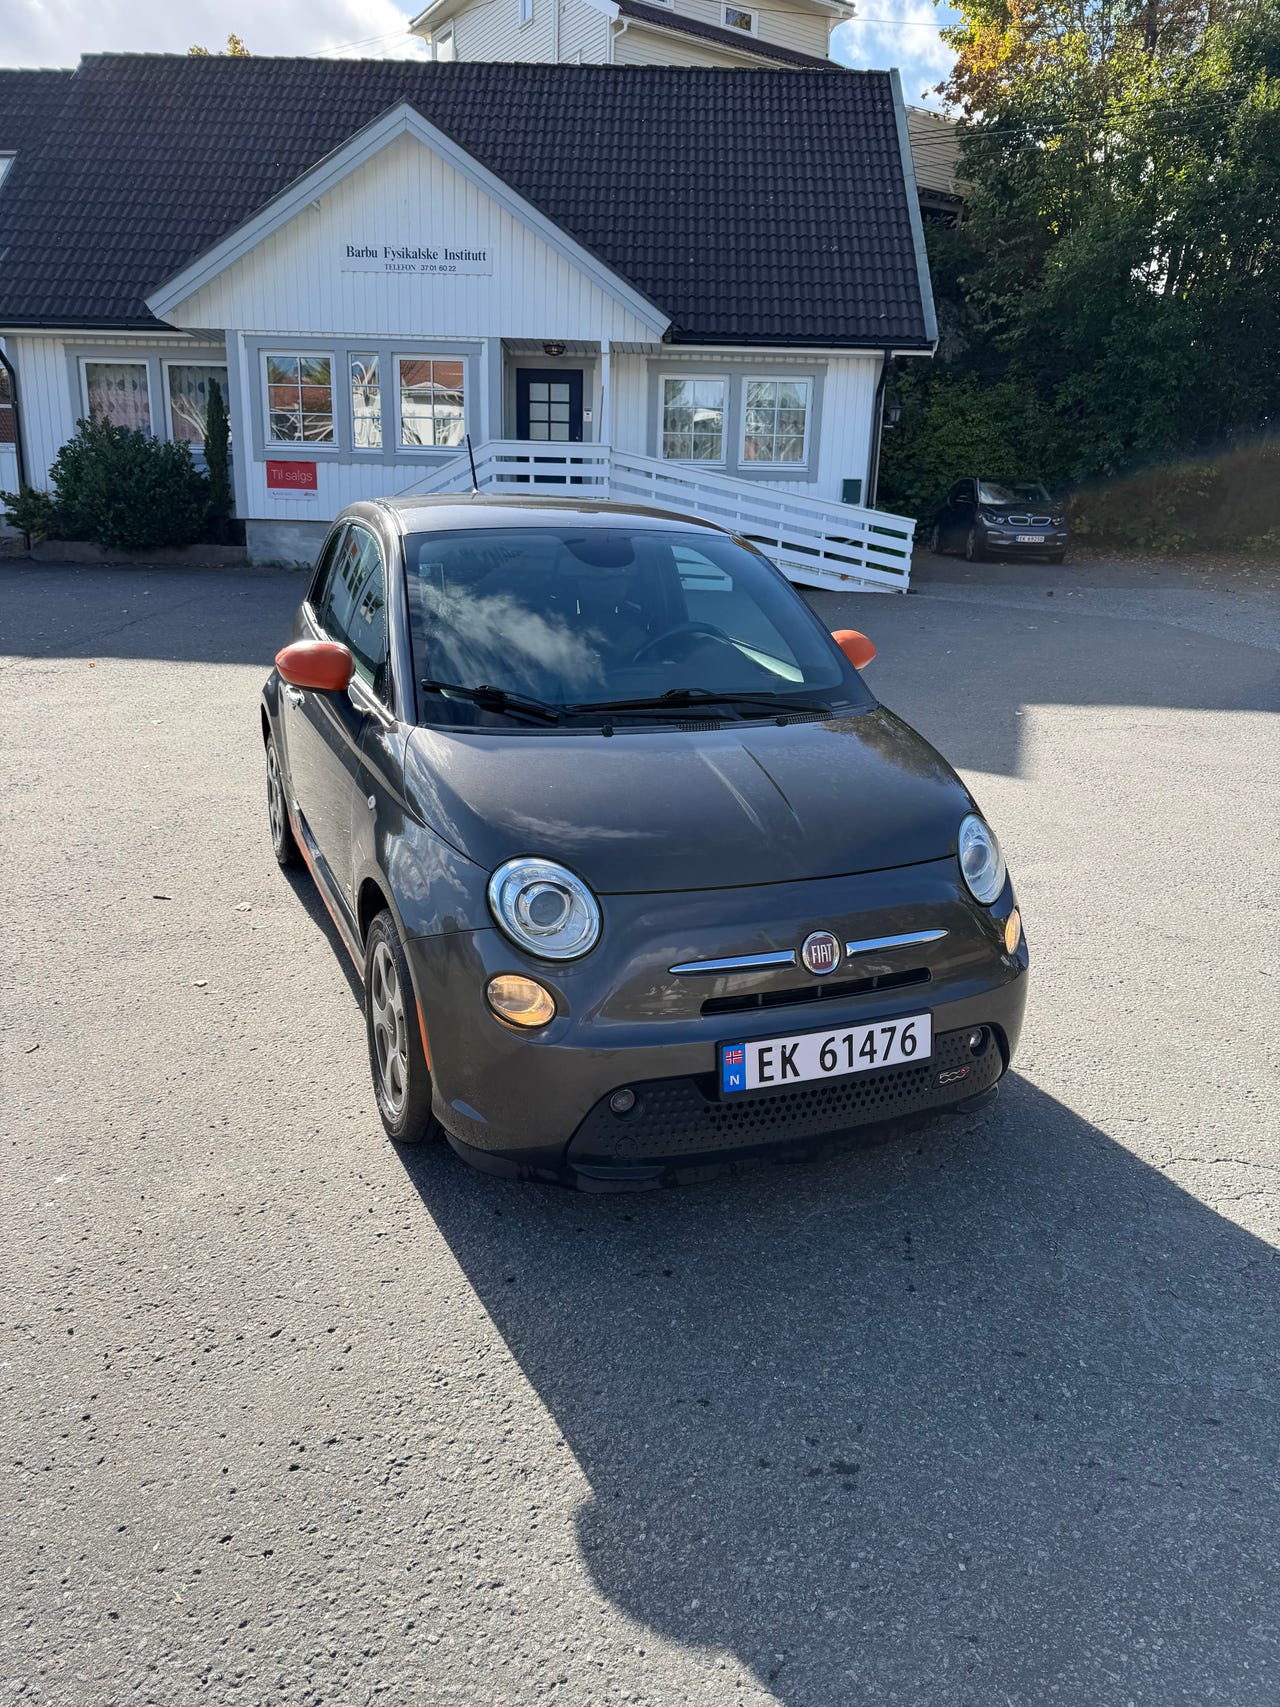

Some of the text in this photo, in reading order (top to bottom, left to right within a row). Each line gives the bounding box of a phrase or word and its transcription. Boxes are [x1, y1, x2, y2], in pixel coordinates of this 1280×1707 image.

[346, 245, 487, 261] Barbu Fysikalske Institutt
[384, 263, 416, 271] TELEFON
[271, 468, 313, 483] Til salgs
[811, 943, 833, 964] FIAT
[729, 1021, 917, 1085] N EK 61476
